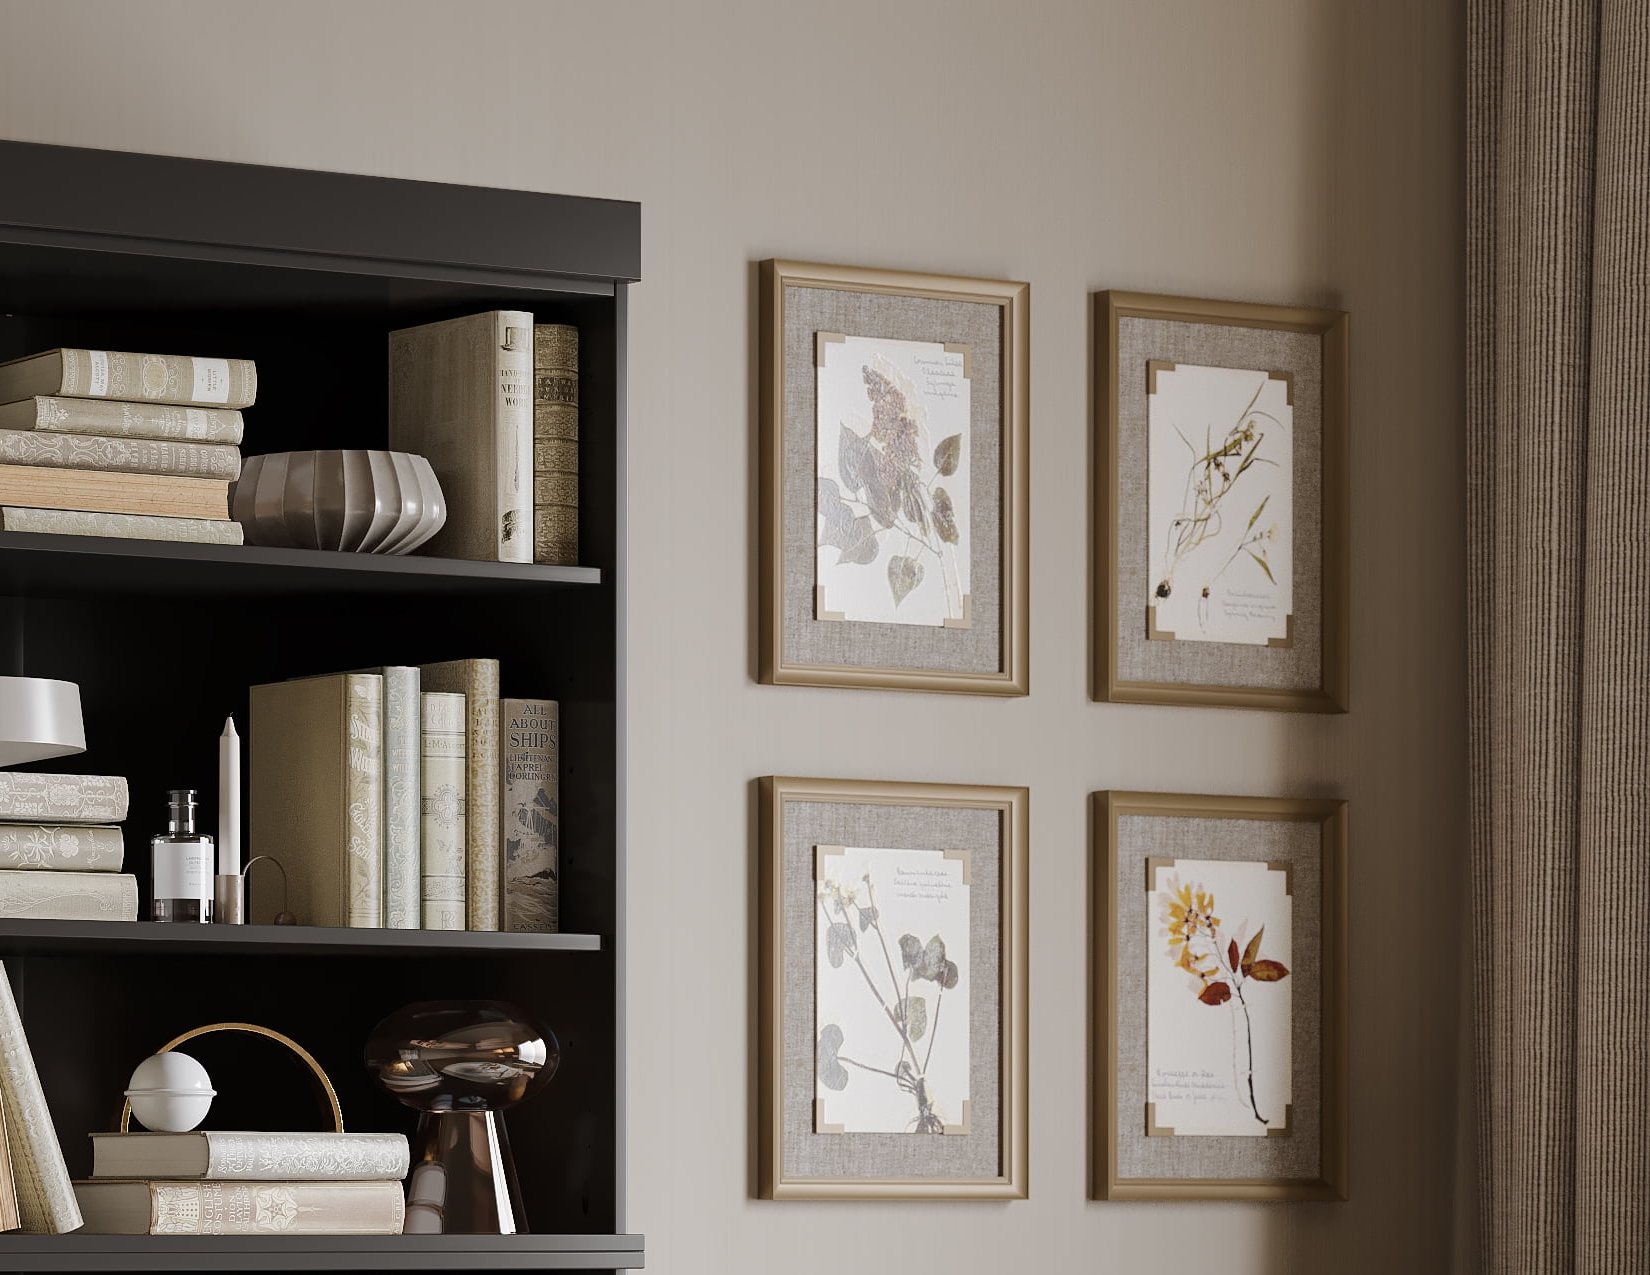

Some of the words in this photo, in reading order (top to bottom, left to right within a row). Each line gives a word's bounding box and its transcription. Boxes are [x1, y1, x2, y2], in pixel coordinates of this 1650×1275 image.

[523, 704, 547, 716] ALL
[509, 718, 557, 731] ABOUT
[509, 732, 557, 751] SHIPS
[203, 1184, 212, 1234] ENGLISH
[212, 1183, 222, 1235] COSTUME
